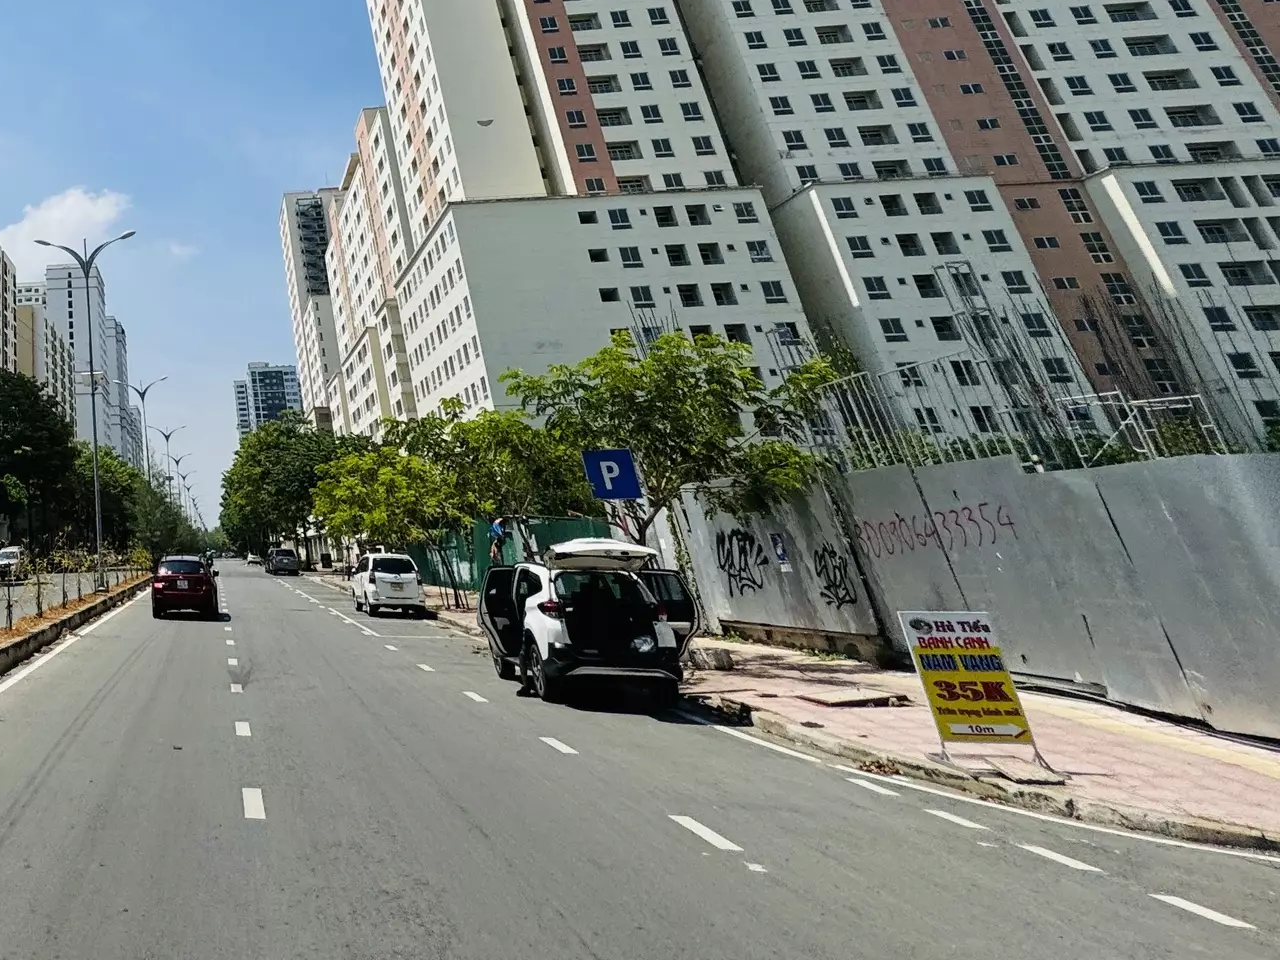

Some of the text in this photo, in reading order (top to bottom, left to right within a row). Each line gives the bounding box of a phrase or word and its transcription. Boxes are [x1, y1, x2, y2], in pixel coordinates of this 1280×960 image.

[599, 461, 620, 490] P
[954, 636, 991, 651] CANH
[919, 653, 960, 671] NAM
[933, 680, 1014, 702] 35K
[967, 724, 995, 734] 10m
